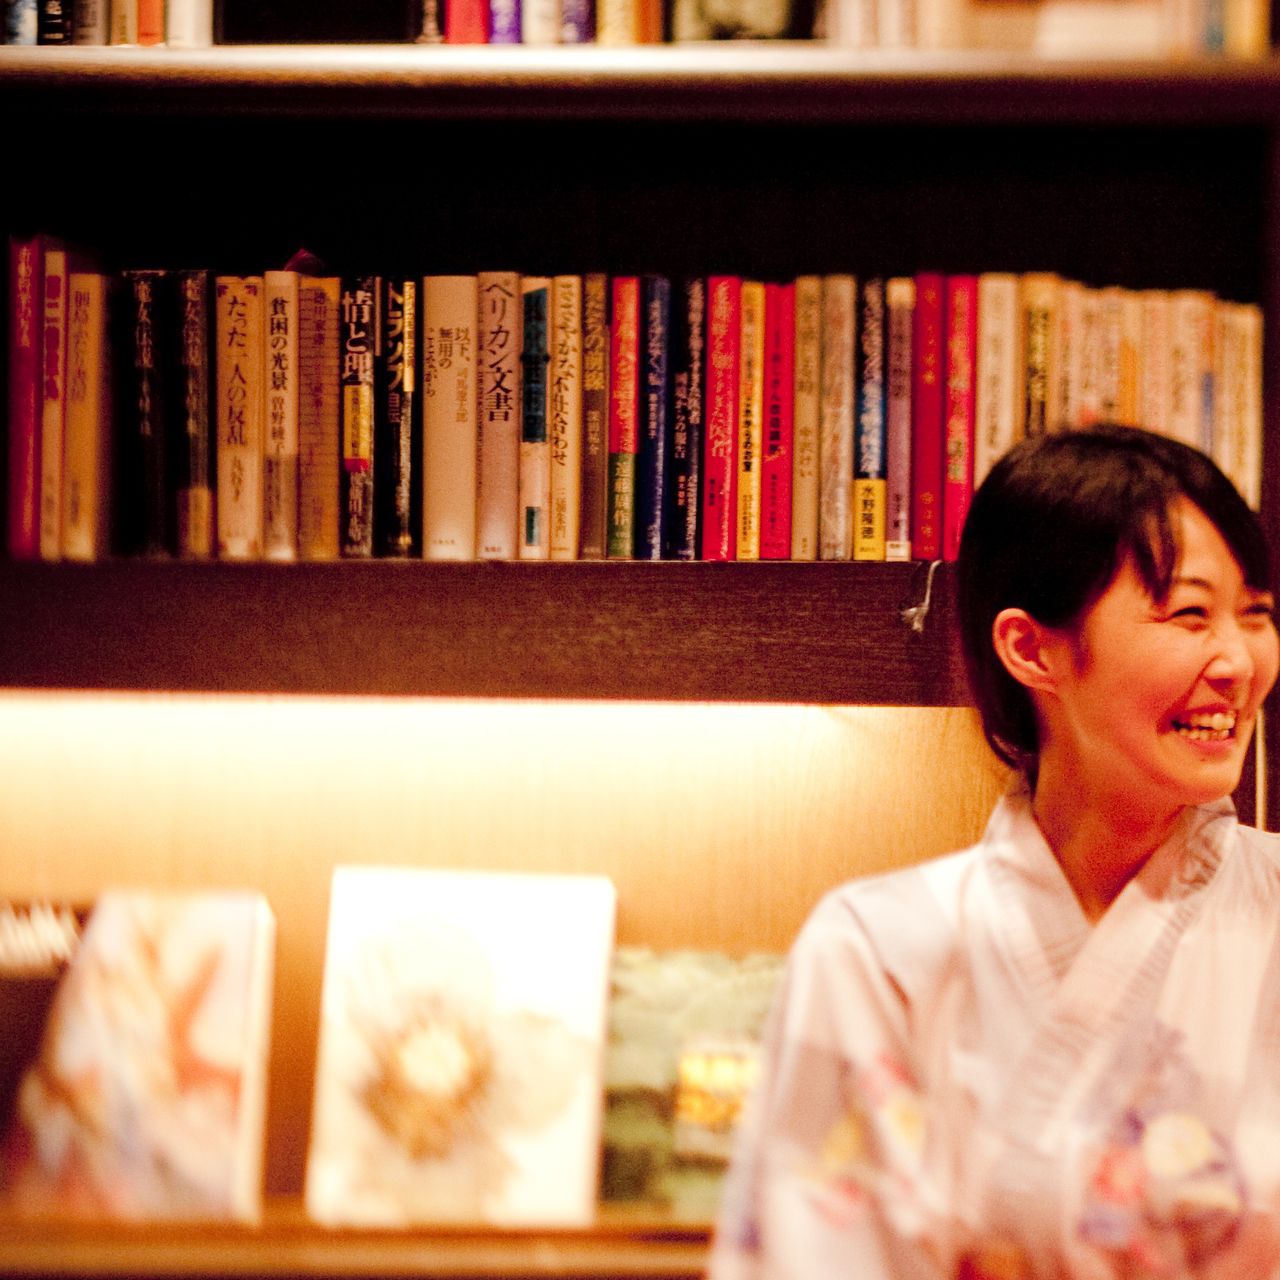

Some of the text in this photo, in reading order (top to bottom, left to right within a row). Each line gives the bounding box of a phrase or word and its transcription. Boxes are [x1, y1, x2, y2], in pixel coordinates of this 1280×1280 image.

[227, 295, 248, 445] たった一人の反乱
[270, 296, 289, 391] 貧困の光景
[483, 278, 514, 421] ペリカン文書
